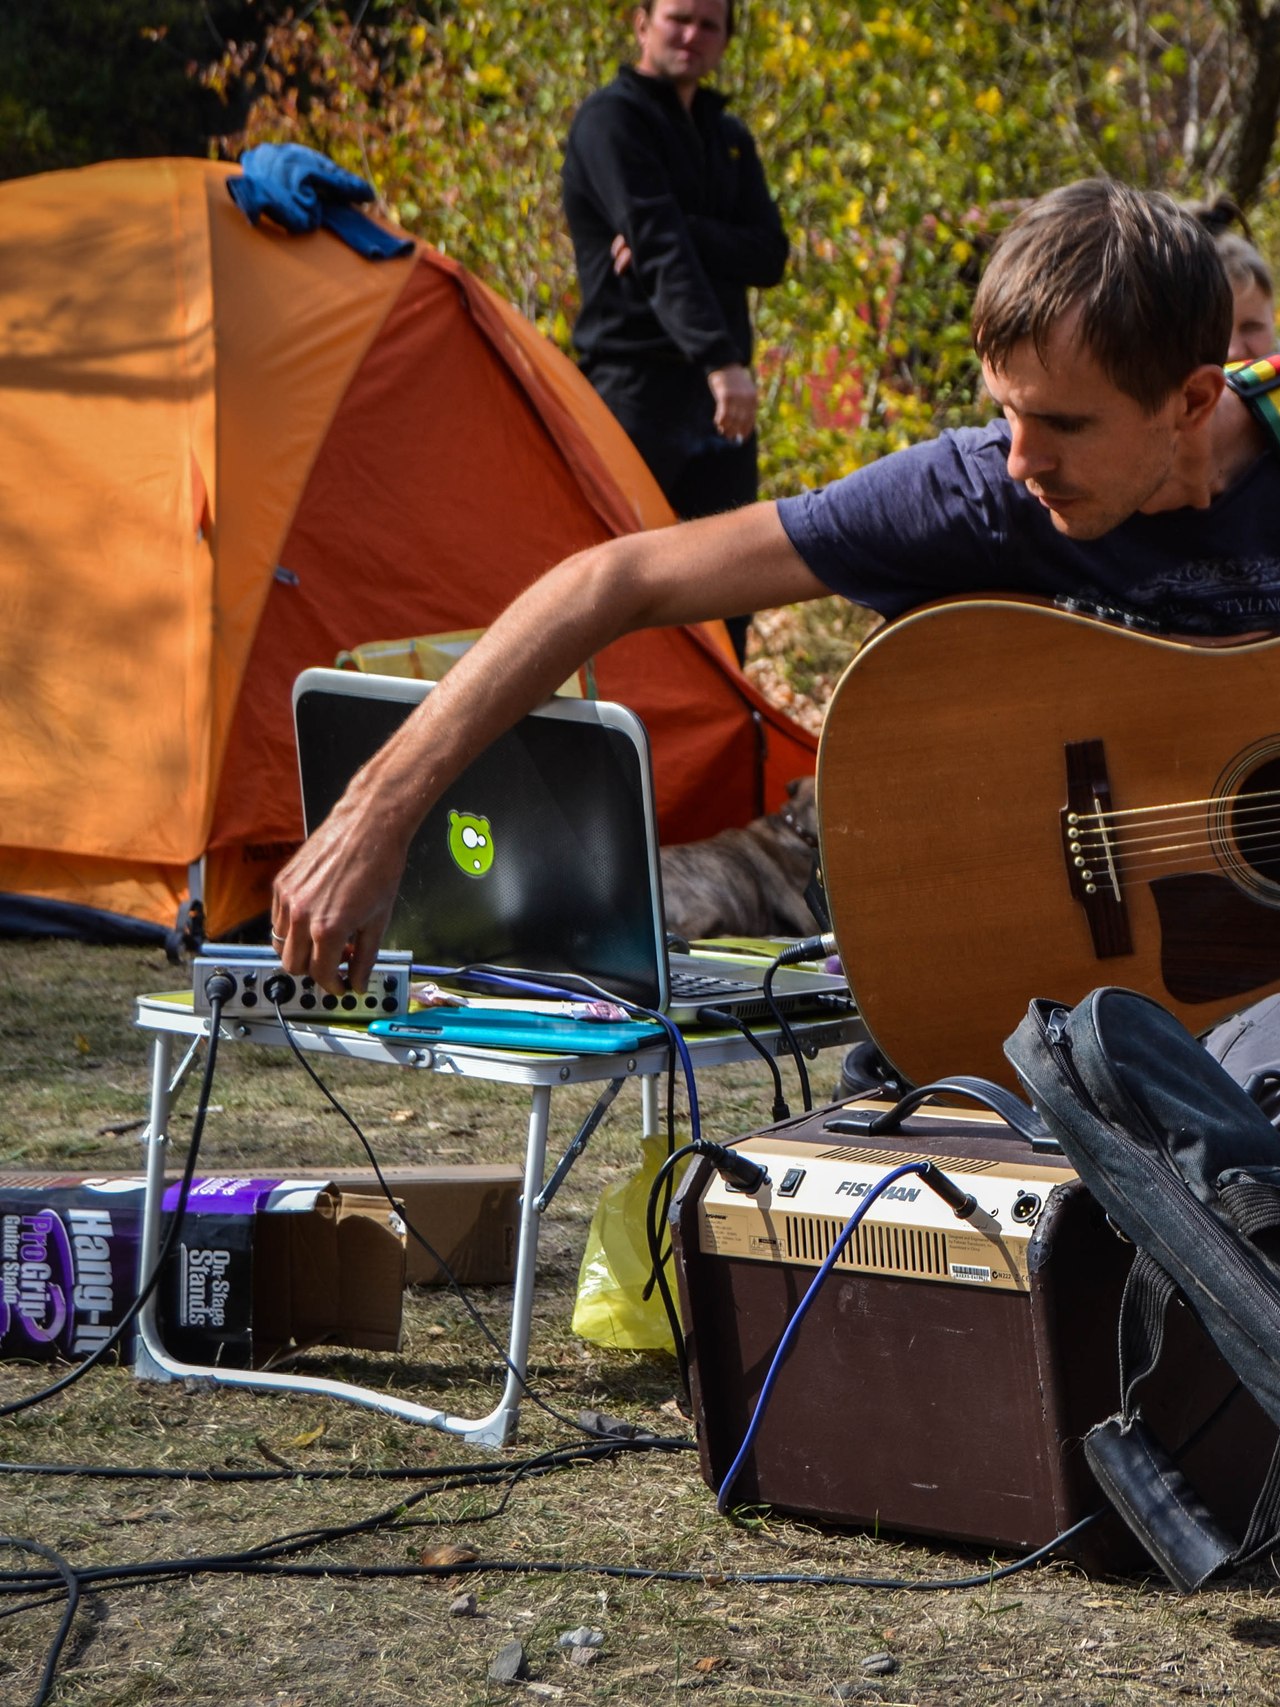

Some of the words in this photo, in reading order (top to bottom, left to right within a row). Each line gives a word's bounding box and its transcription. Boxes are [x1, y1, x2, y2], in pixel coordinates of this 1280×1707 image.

[4, 1214, 20, 1260] Guitar
[19, 1215, 52, 1319] ProGrip
[2, 1261, 20, 1304] Stand
[189, 1250, 212, 1326] Stands
[209, 1250, 231, 1326] On-Stage
